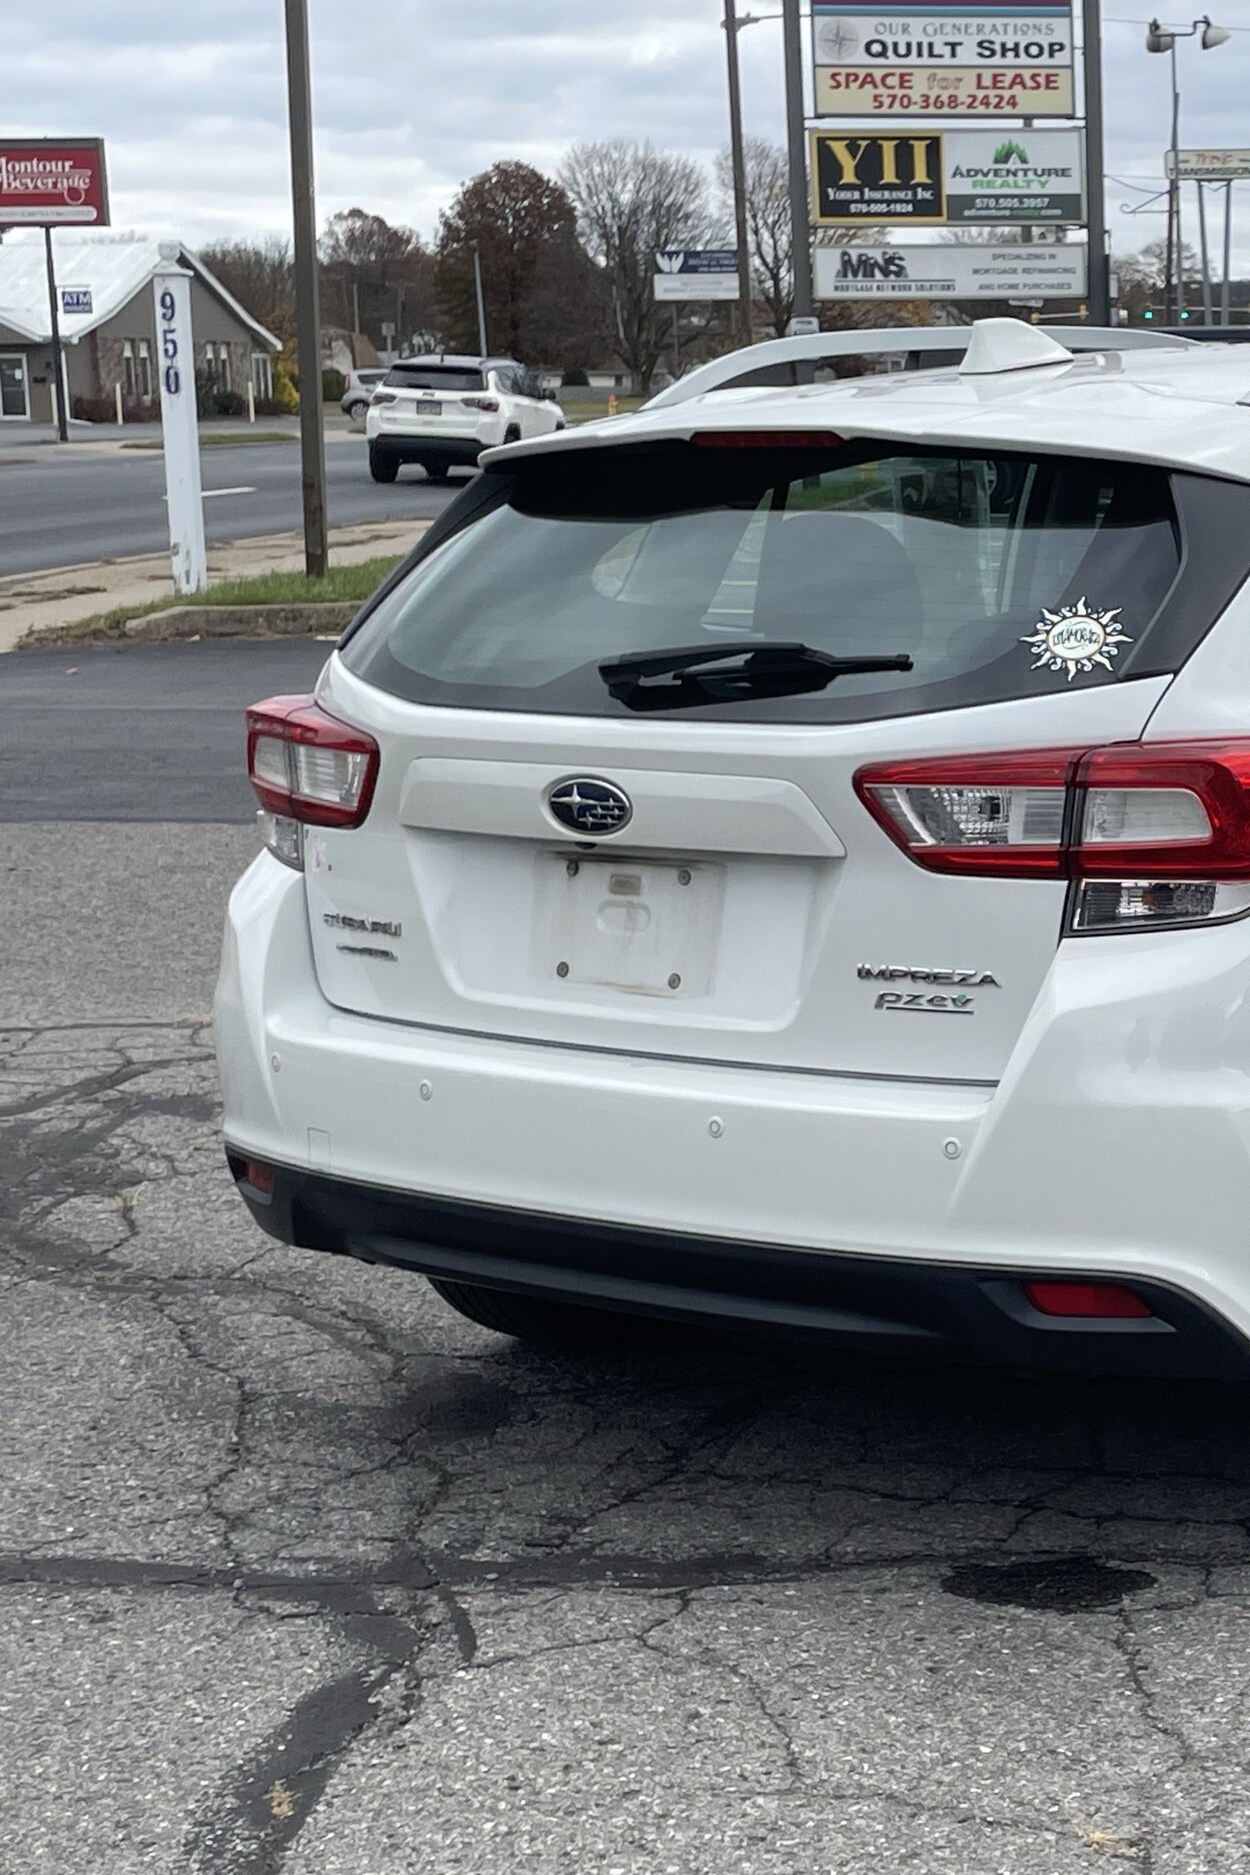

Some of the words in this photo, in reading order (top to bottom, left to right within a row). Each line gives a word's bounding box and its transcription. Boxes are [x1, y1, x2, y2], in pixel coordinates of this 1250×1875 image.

[874, 22, 912, 36] OUR
[922, 22, 1055, 37] GENERATIONS
[864, 39, 963, 59] QUILT
[976, 39, 1067, 59] SHOP
[829, 72, 914, 90] SPACE
[926, 72, 963, 91] for
[975, 72, 1060, 90] LEASE
[872, 94, 1018, 110] 570-368-2424
[825, 140, 934, 185] YII
[951, 165, 1073, 178] ADVENTURE
[971, 179, 1050, 189] REALTY
[159, 290, 181, 396] 950
[856, 962, 1003, 989] IMPREZA
